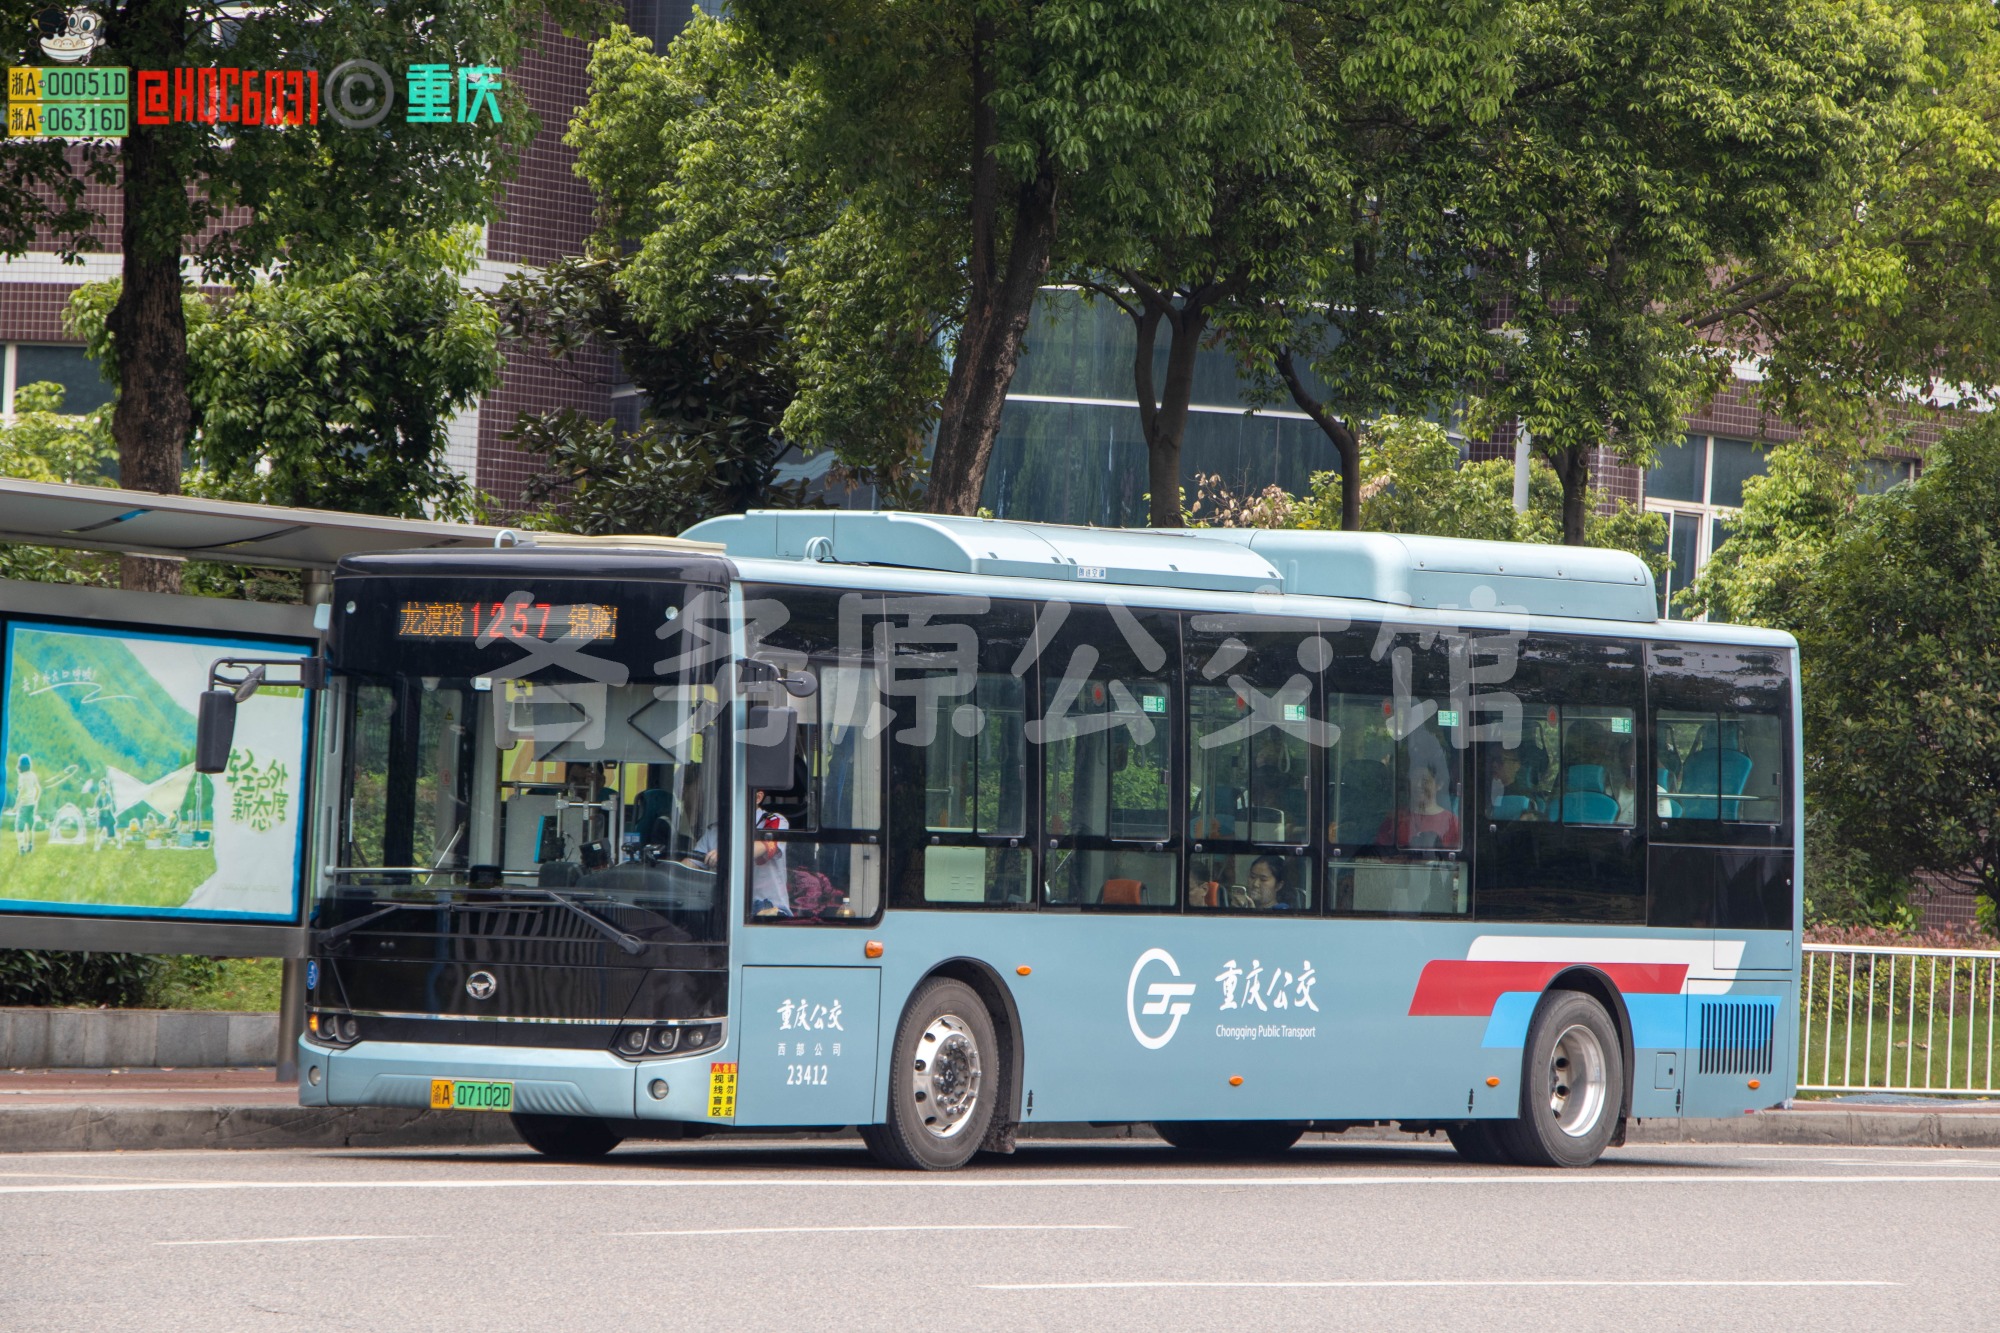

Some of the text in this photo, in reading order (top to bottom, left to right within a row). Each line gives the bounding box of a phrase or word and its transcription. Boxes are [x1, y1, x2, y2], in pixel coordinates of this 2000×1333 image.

[398, 601, 464, 636] 龙渡路
[470, 602, 551, 638] 1257
[1215, 959, 1319, 1012] 重庆公交
[777, 998, 844, 1032] 重庆公交
[1215, 1024, 1316, 1041] Chongqing Public Transport
[777, 1042, 842, 1057] 西部公司
[786, 1064, 828, 1086] 23412
